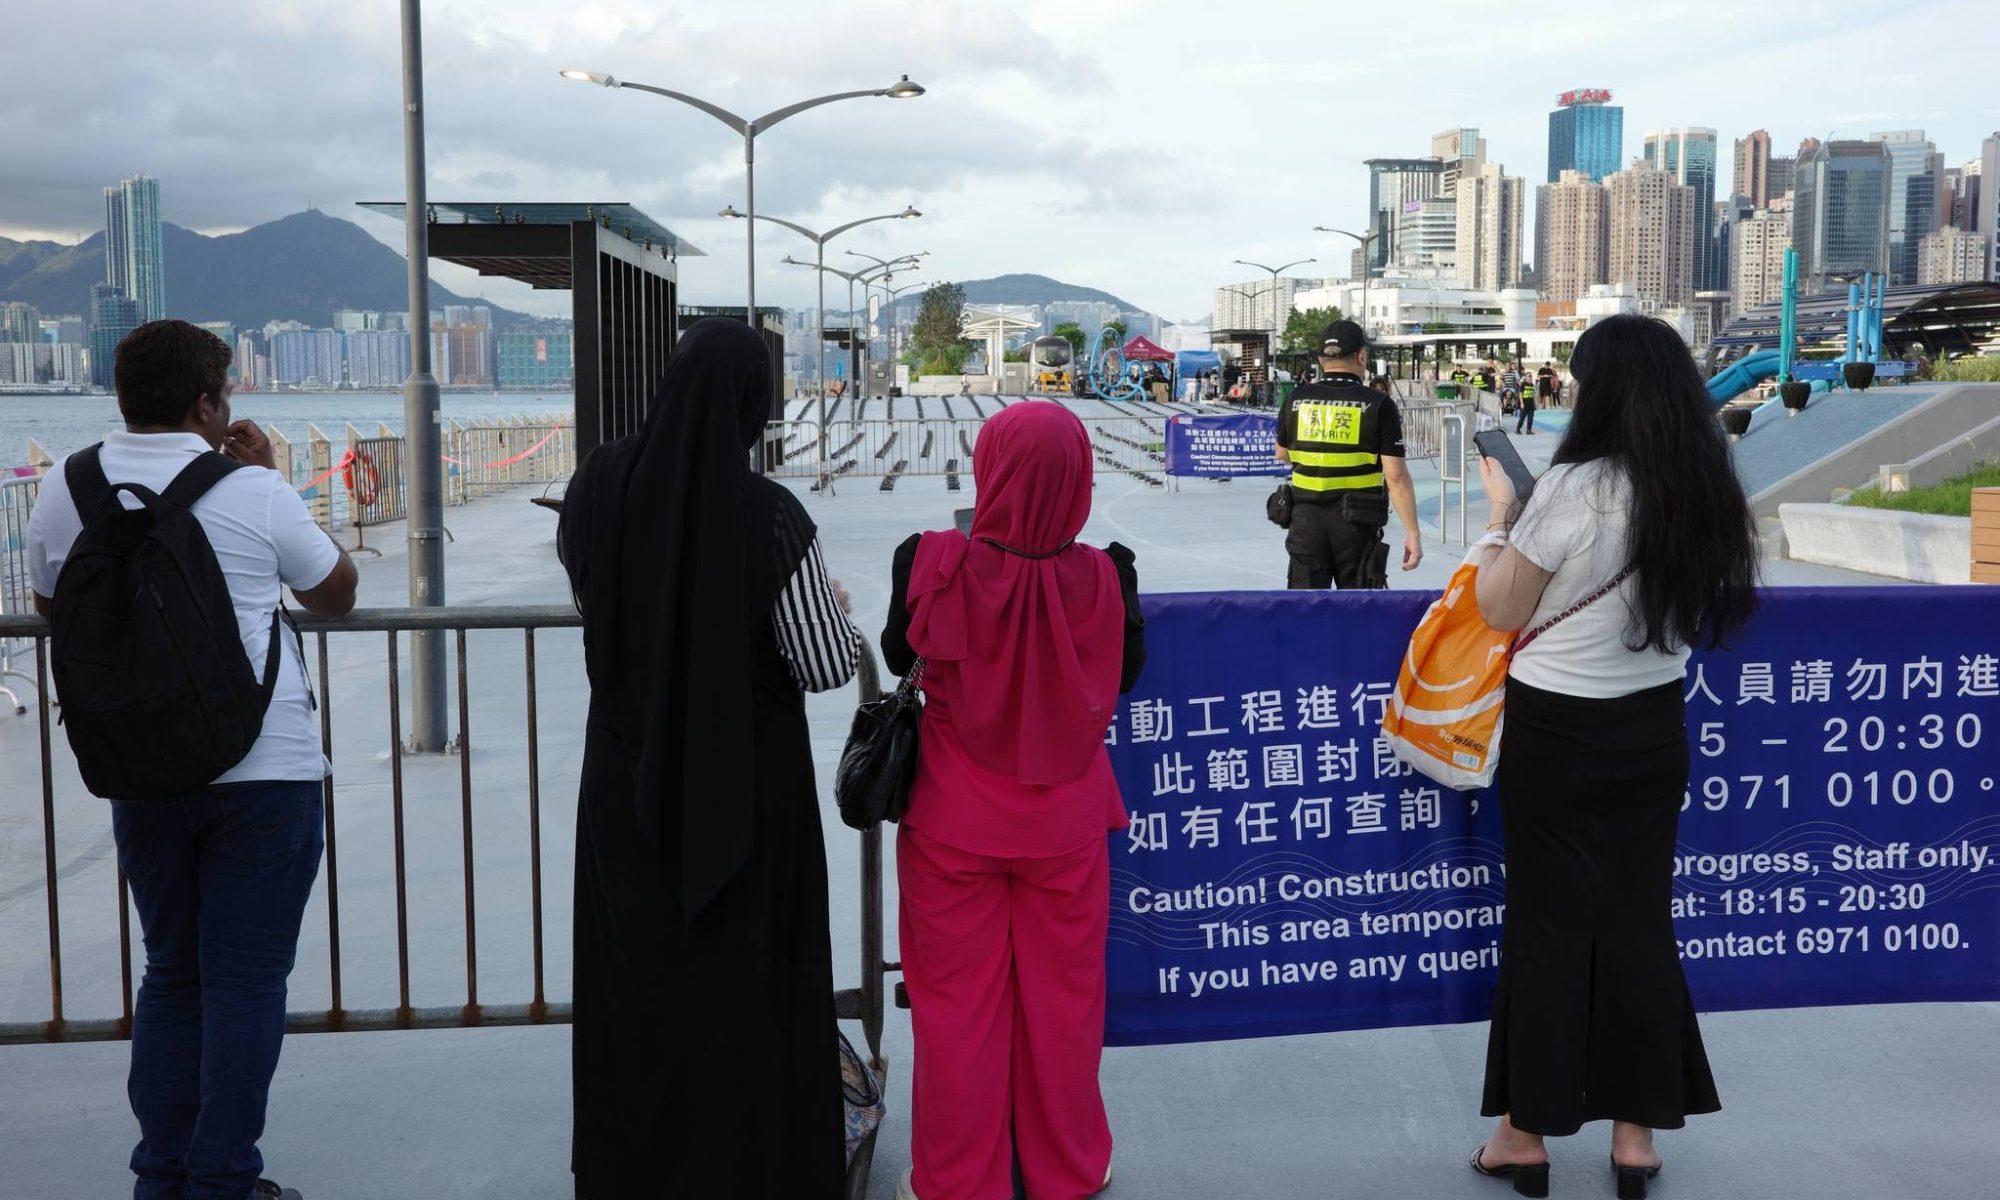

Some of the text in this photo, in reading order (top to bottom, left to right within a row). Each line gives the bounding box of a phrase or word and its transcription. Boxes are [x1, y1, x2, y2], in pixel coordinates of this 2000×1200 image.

[1304, 427, 1351, 439] SECURITY
[1823, 713, 1982, 753] 20:30
[1128, 877, 1267, 914] Caution!
[1278, 861, 1490, 901] Construction
[1831, 842, 1910, 871] Staff
[1917, 840, 1994, 873] only.
[1198, 919, 1270, 949] This
[1279, 916, 1351, 942] area
[1359, 904, 1506, 938] temporar
[1670, 891, 1706, 919] at:
[1719, 887, 1807, 915] 18:15
[1838, 883, 1926, 912] 20:30
[1158, 966, 1181, 994] If
[1188, 967, 1250, 998] you
[1260, 959, 1338, 986] have
[1348, 954, 1407, 982] any
[1417, 940, 1502, 979] queri
[1796, 925, 1870, 954] 6971
[1883, 922, 1970, 951] 0100.
